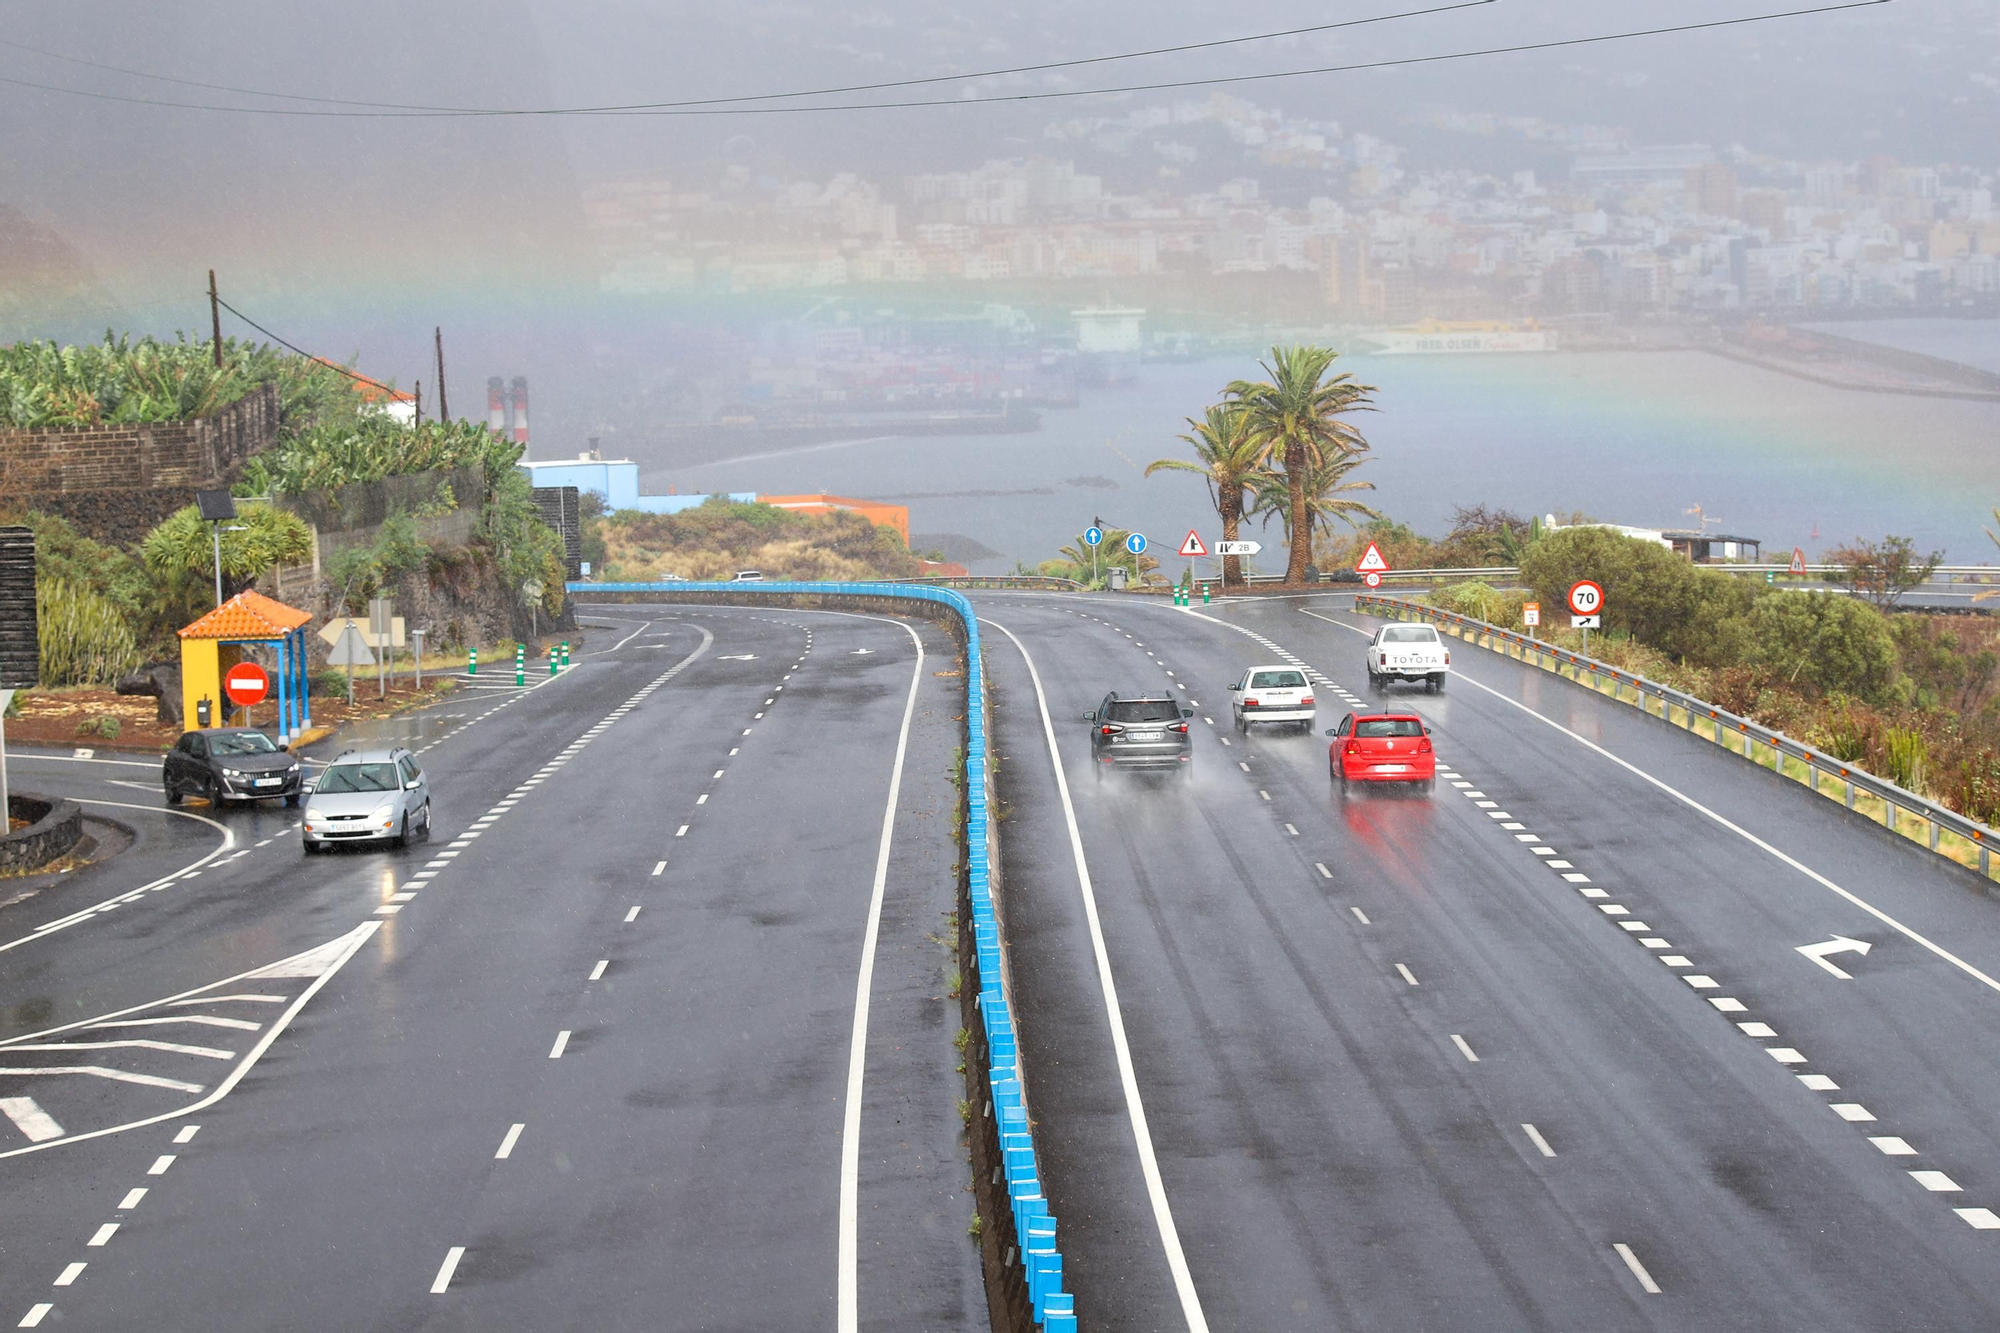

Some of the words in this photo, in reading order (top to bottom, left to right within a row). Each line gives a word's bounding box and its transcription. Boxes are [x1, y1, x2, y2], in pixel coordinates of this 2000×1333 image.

[1447, 339, 1481, 350] OLSEN
[1238, 544, 1250, 552] 2B
[1368, 576, 1378, 584] 50
[1577, 593, 1595, 604] 70
[1393, 656, 1437, 664] TOYOTA
